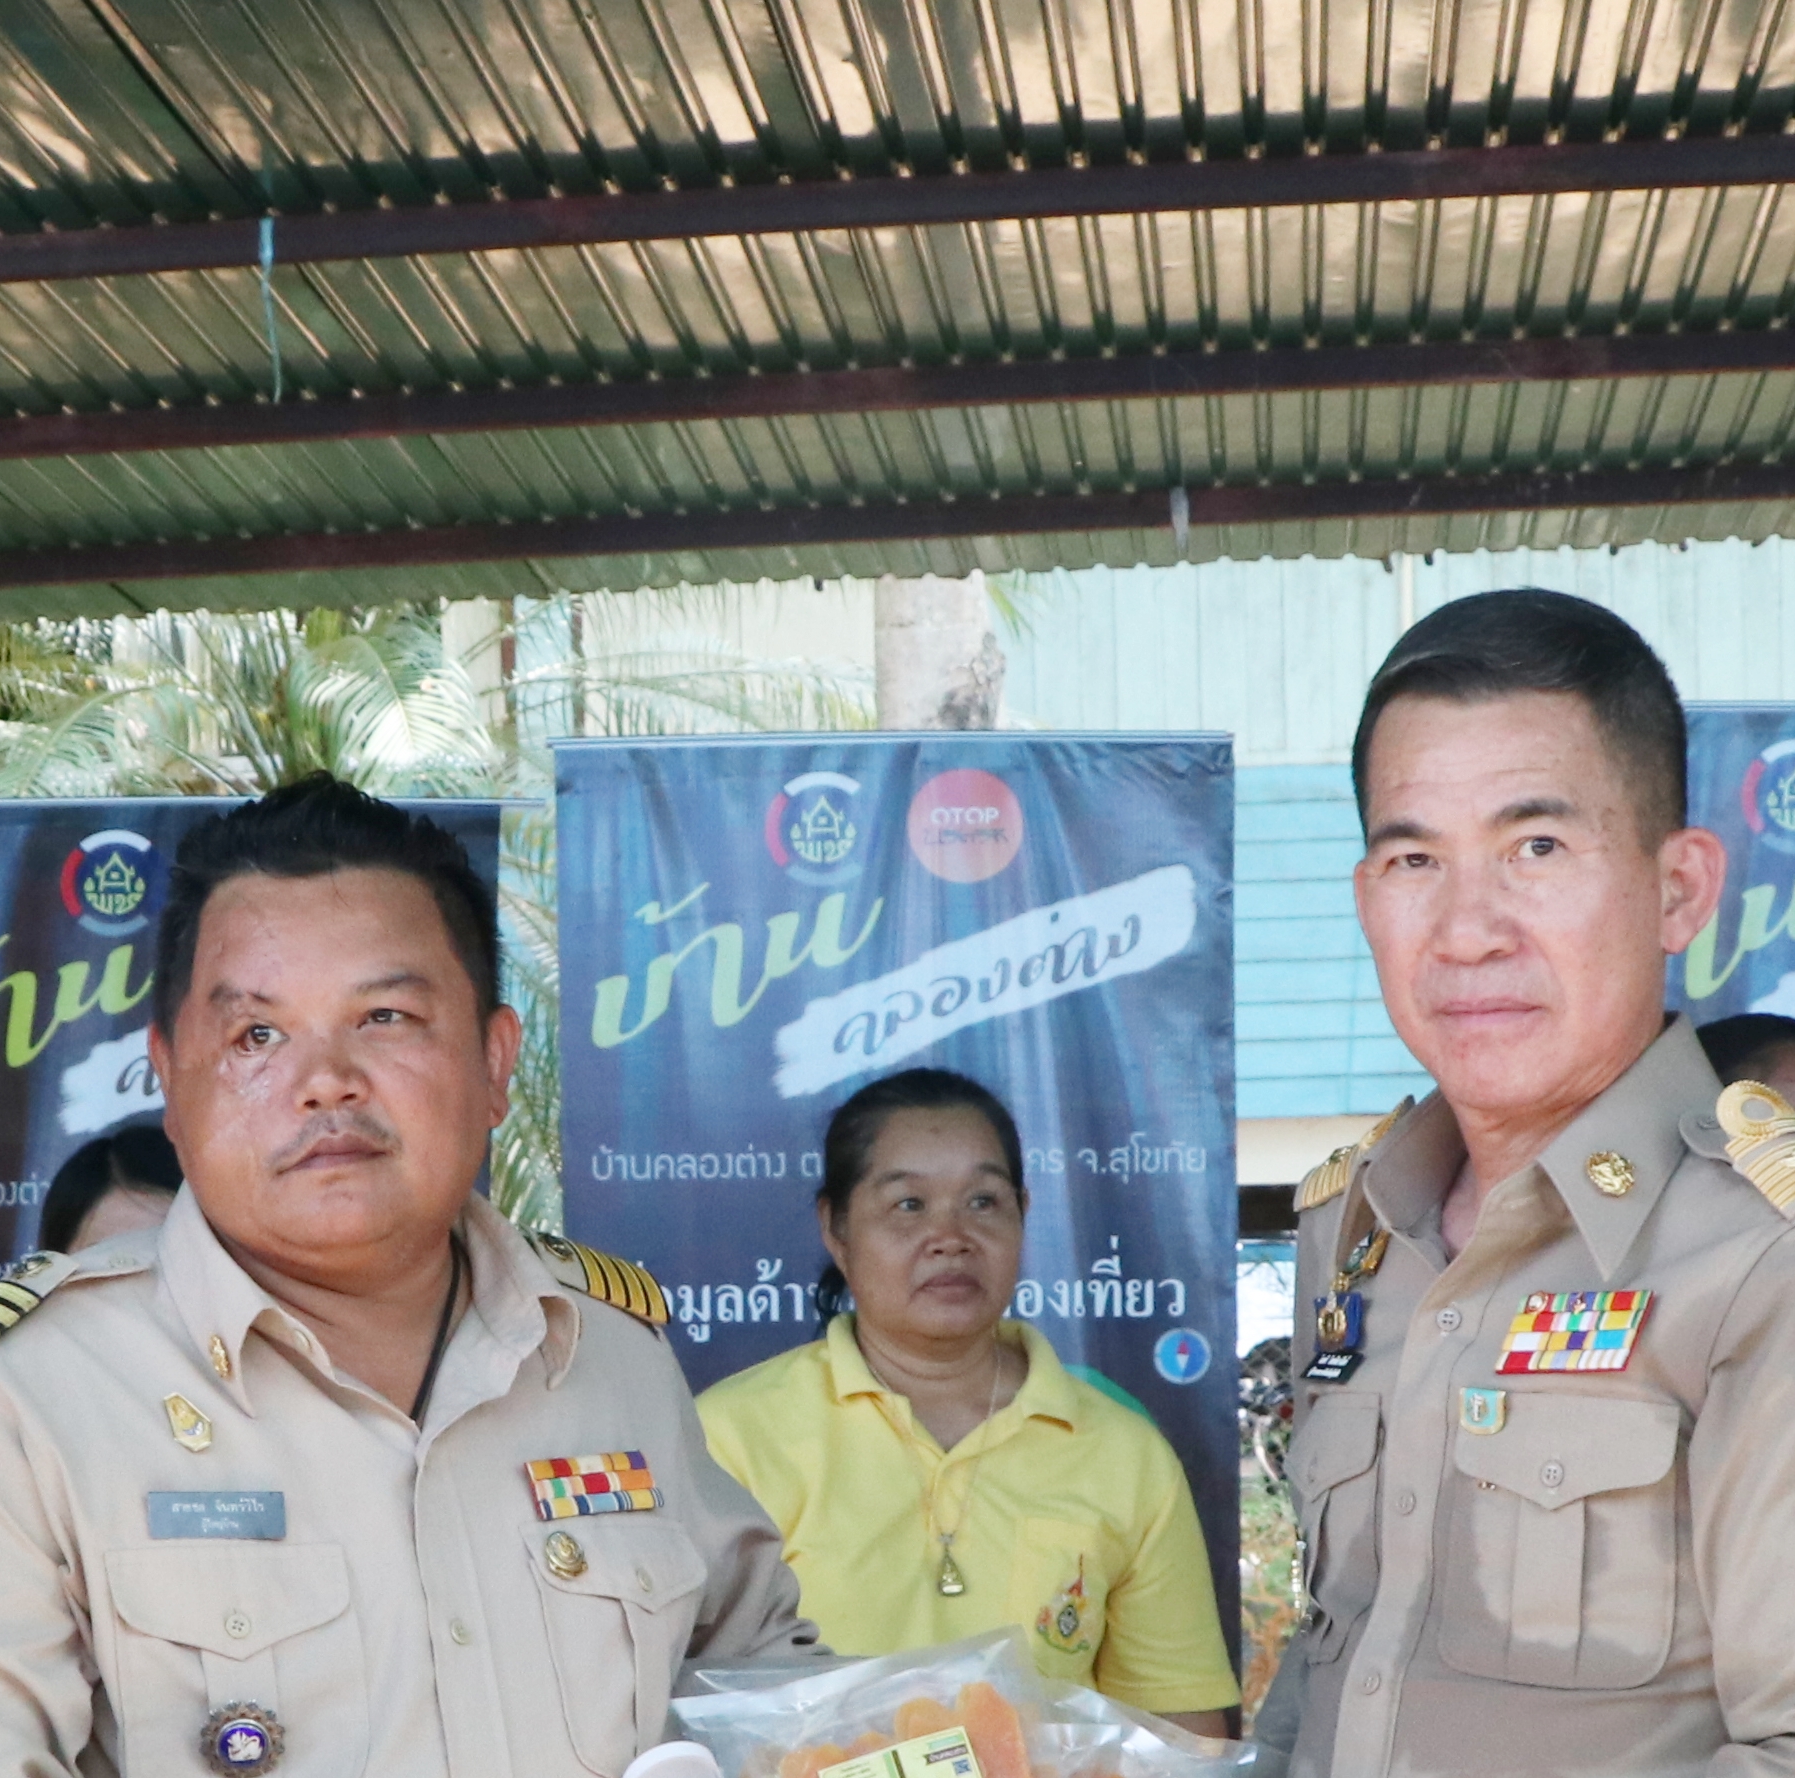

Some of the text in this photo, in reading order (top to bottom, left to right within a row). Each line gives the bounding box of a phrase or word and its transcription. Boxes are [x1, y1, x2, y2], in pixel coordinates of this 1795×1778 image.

[930, 806, 1000, 825] OTOP
[592, 882, 884, 1048] บ้าน
[832, 912, 1143, 1057] คลองต่าง
[591, 1142, 787, 1181] บ้านคลองต่าง
[1076, 1130, 1207, 1185] จ.สุโขทัย
